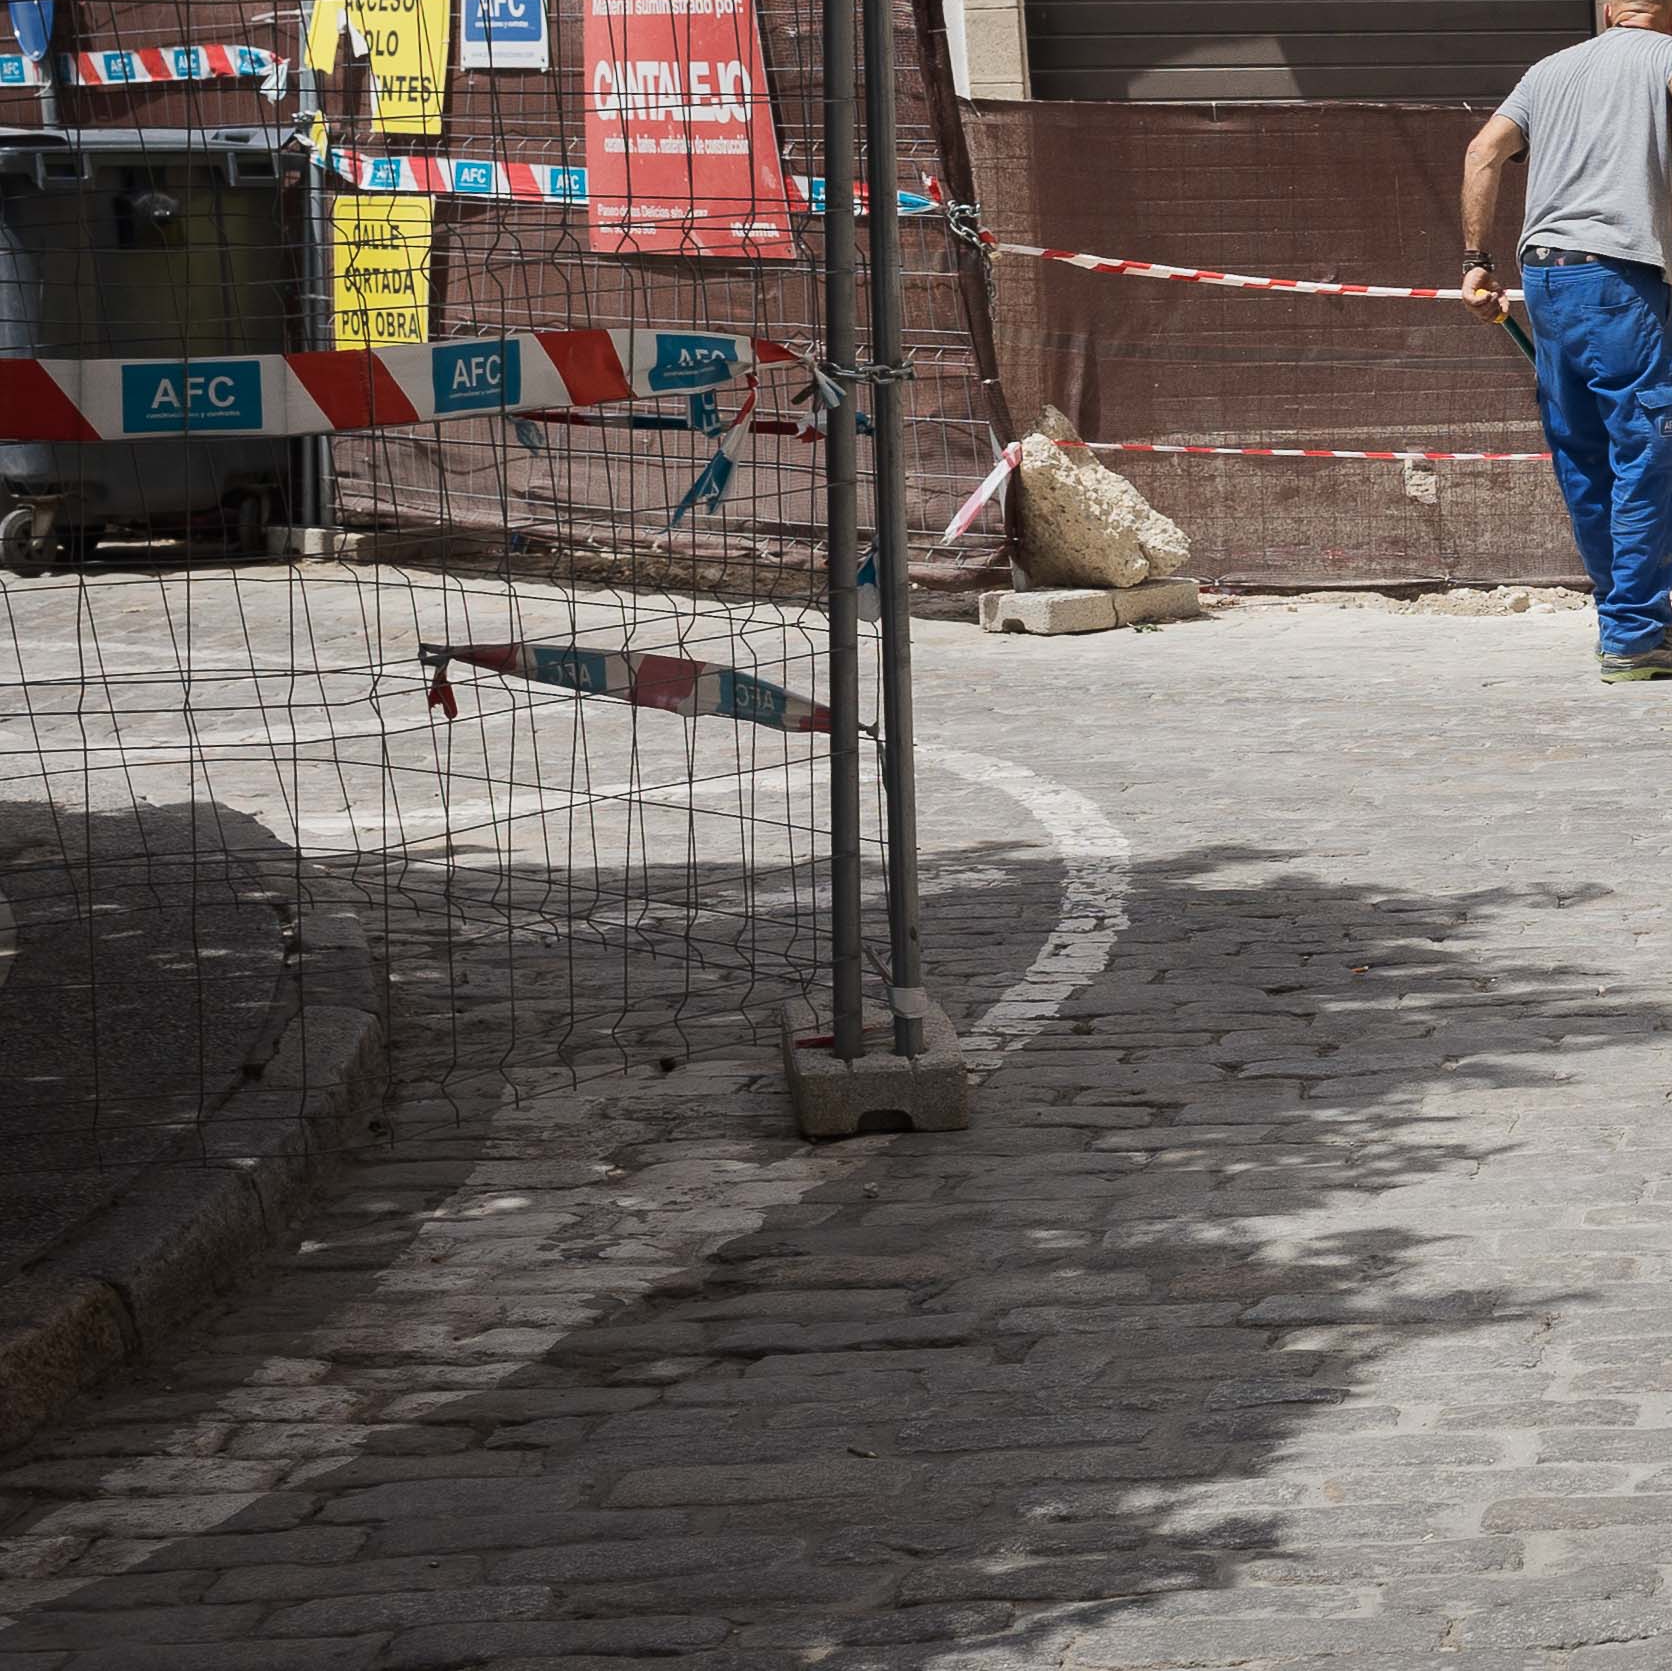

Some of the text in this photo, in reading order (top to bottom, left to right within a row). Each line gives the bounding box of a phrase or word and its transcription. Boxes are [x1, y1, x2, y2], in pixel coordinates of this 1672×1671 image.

[364, 30, 399, 56] OLO
[593, 59, 753, 124] CANTALEJO
[461, 166, 487, 184] AFC
[344, 266, 414, 295] CORTADA
[375, 313, 419, 339] OBRA
[452, 354, 502, 389] AFC
[151, 376, 236, 409] AFC
